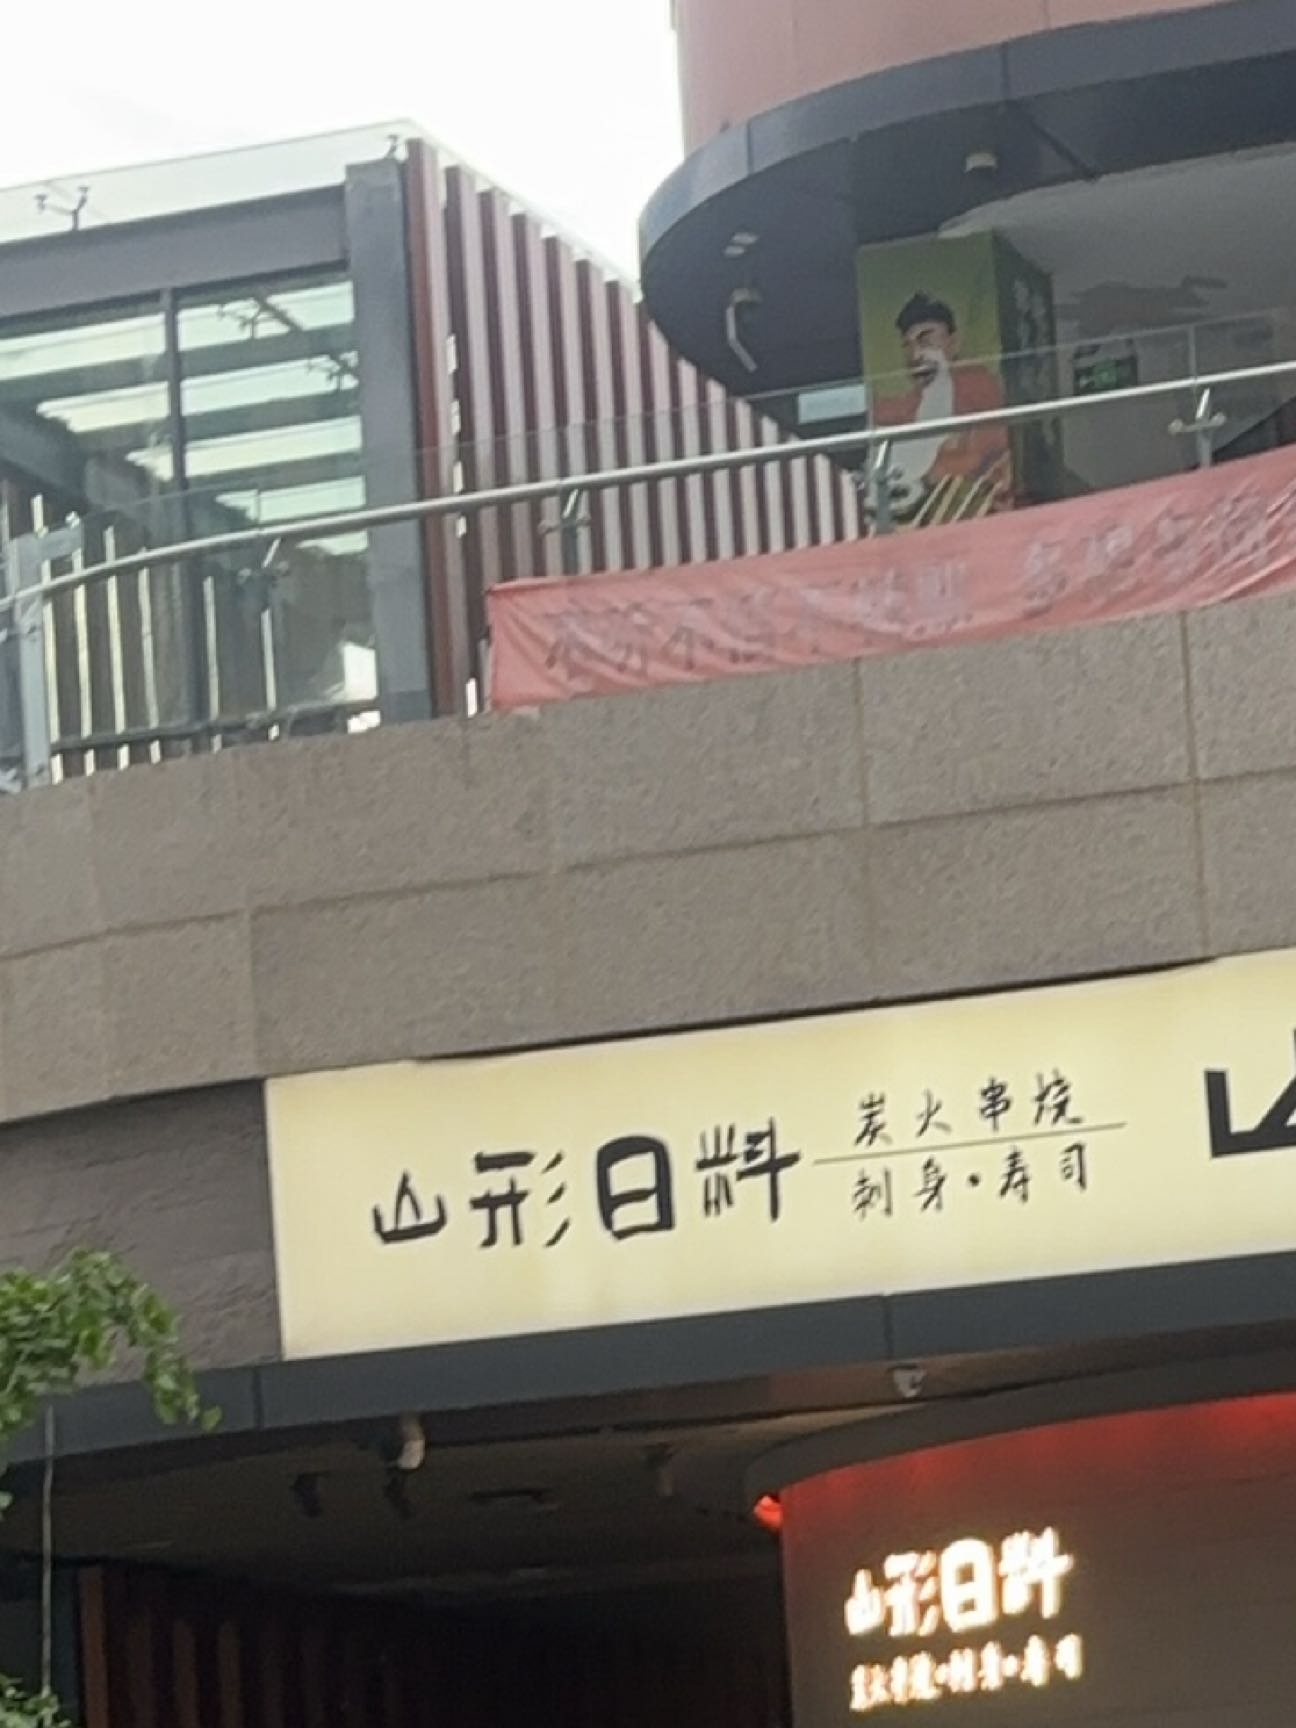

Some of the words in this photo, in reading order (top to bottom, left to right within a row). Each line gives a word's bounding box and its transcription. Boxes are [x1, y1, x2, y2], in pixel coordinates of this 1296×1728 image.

[854, 1068, 1084, 1147] 炭火串烧
[373, 1118, 800, 1248] 山形日料
